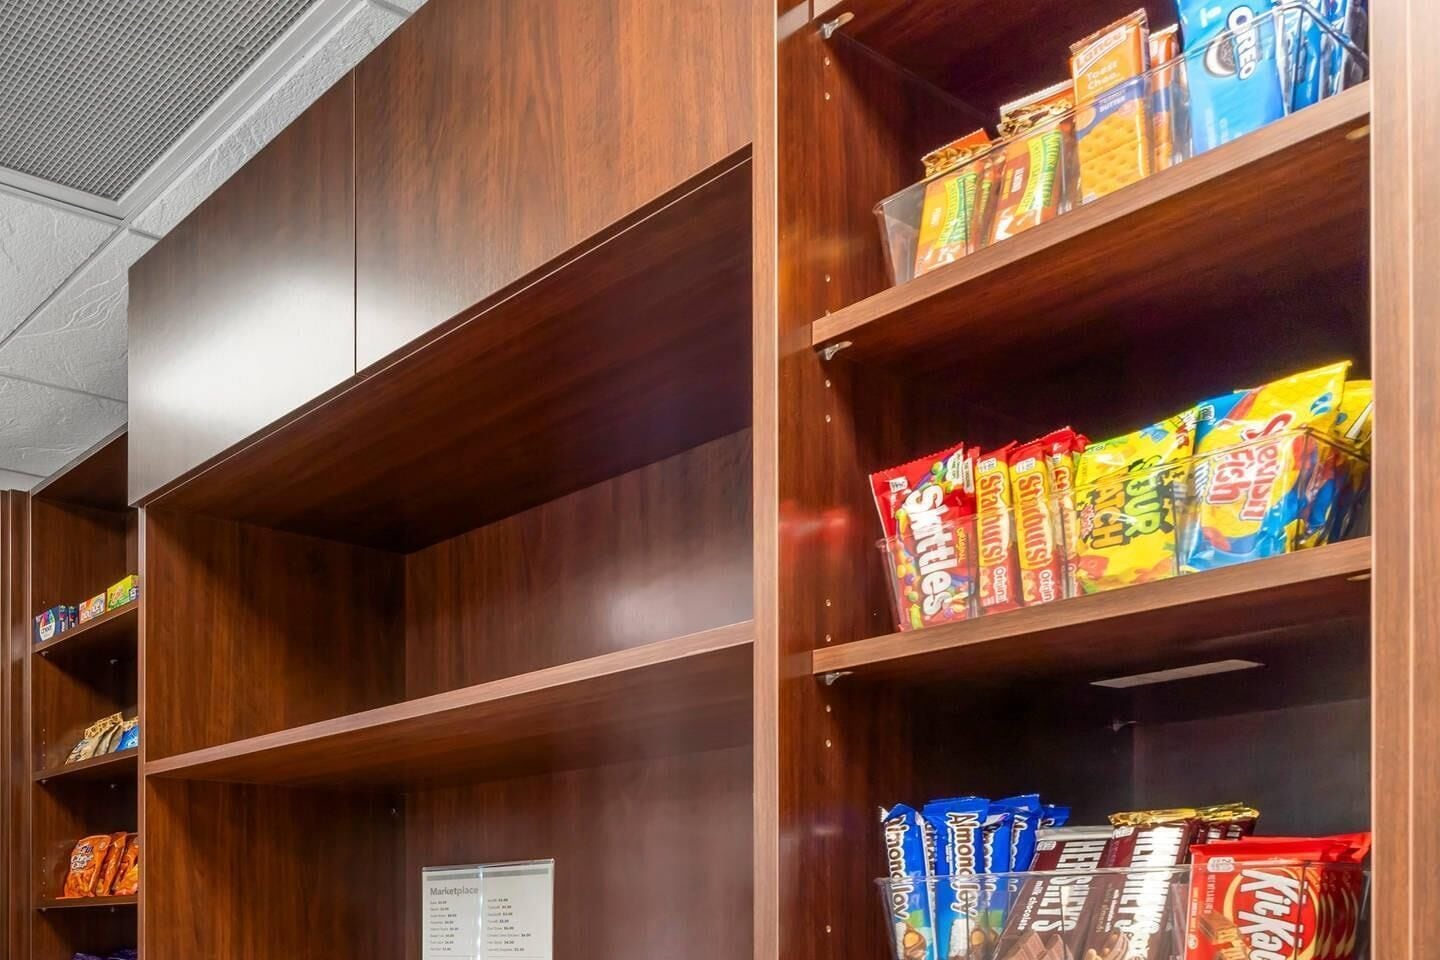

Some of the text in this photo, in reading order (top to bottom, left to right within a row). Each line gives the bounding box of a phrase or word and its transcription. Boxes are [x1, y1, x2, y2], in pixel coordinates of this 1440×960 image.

[1227, 7, 1259, 80] OREO
[1241, 412, 1293, 521] Sedish
[905, 484, 958, 616] Skittles
[980, 473, 1009, 567] Starburst
[1018, 473, 1053, 569] Starburst
[994, 567, 1008, 604] Original
[1039, 569, 1054, 602] Origin
[430, 886, 479, 896] Marketplace
